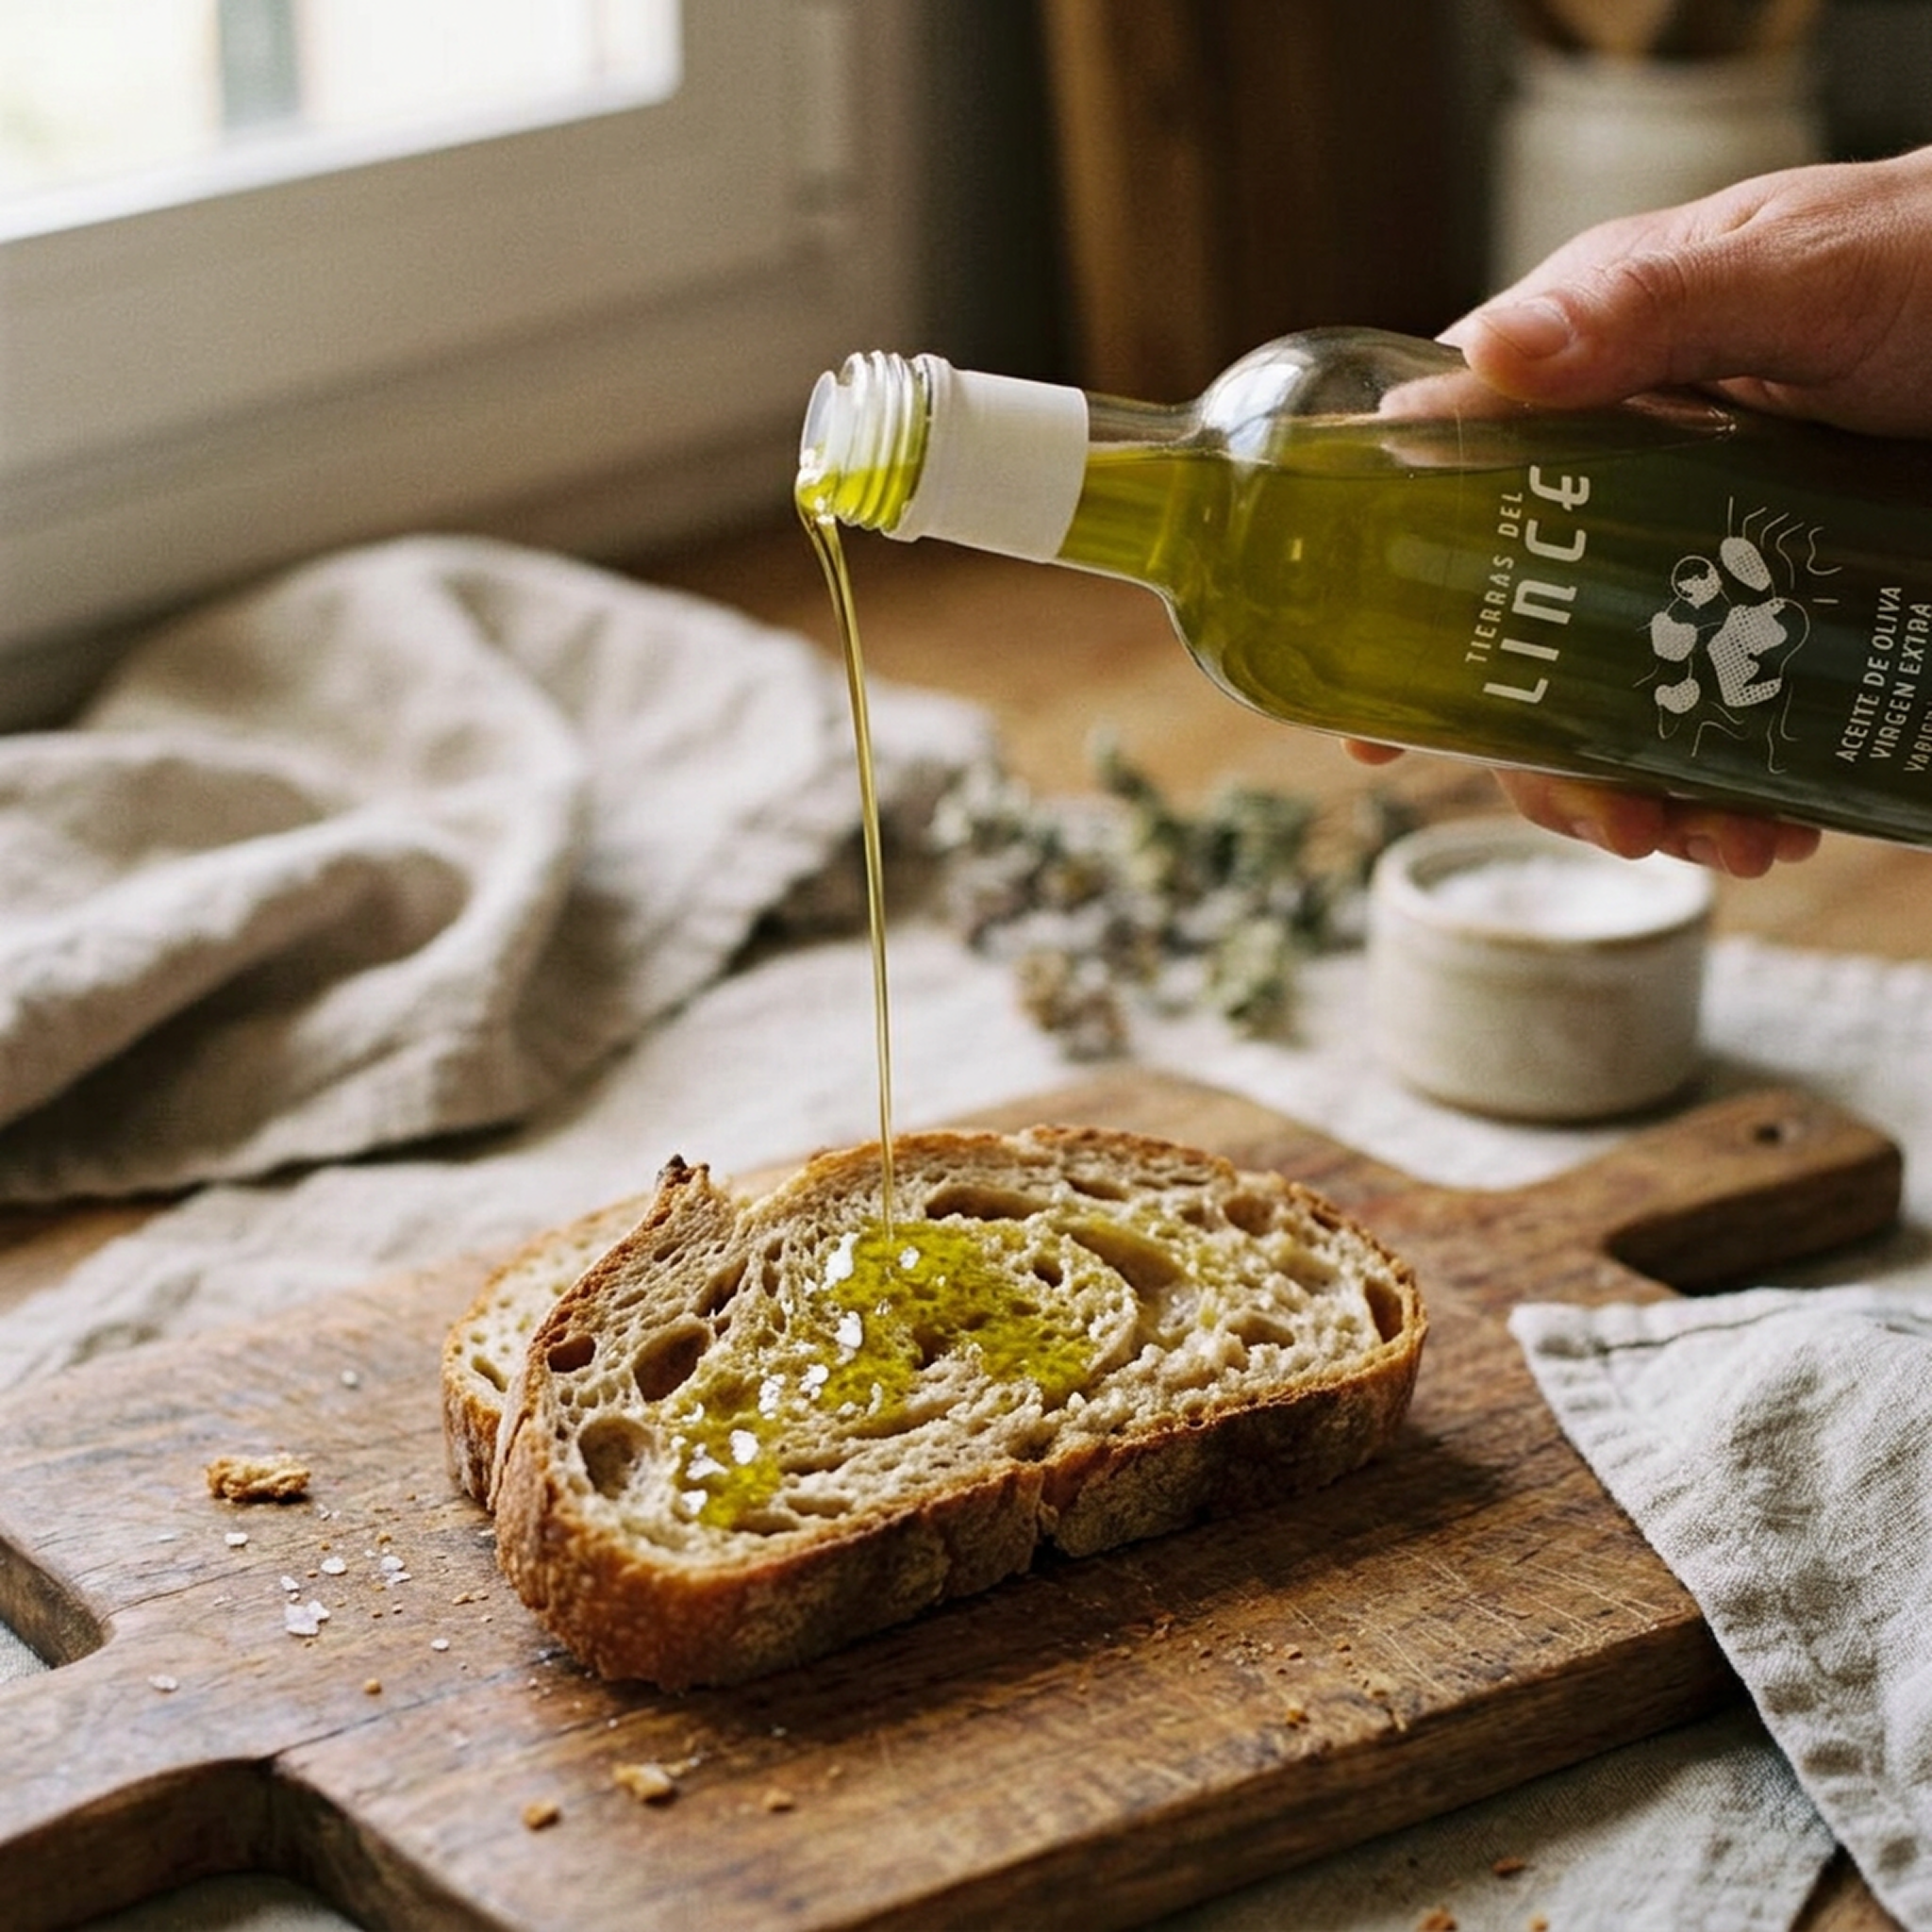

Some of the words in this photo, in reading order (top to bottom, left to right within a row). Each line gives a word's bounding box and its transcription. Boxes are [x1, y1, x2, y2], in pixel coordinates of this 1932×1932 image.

[1465, 555, 1514, 662] TIERRAS
[1498, 491, 1523, 538] DEL
[1483, 465, 1590, 704] LINCE
[1872, 587, 1902, 651] OLIVA
[1835, 693, 1880, 762] ACEITE
[1863, 657, 1890, 687] DE
[1869, 682, 1916, 758] VIRGEN
[1899, 604, 1931, 675] EXTRA
